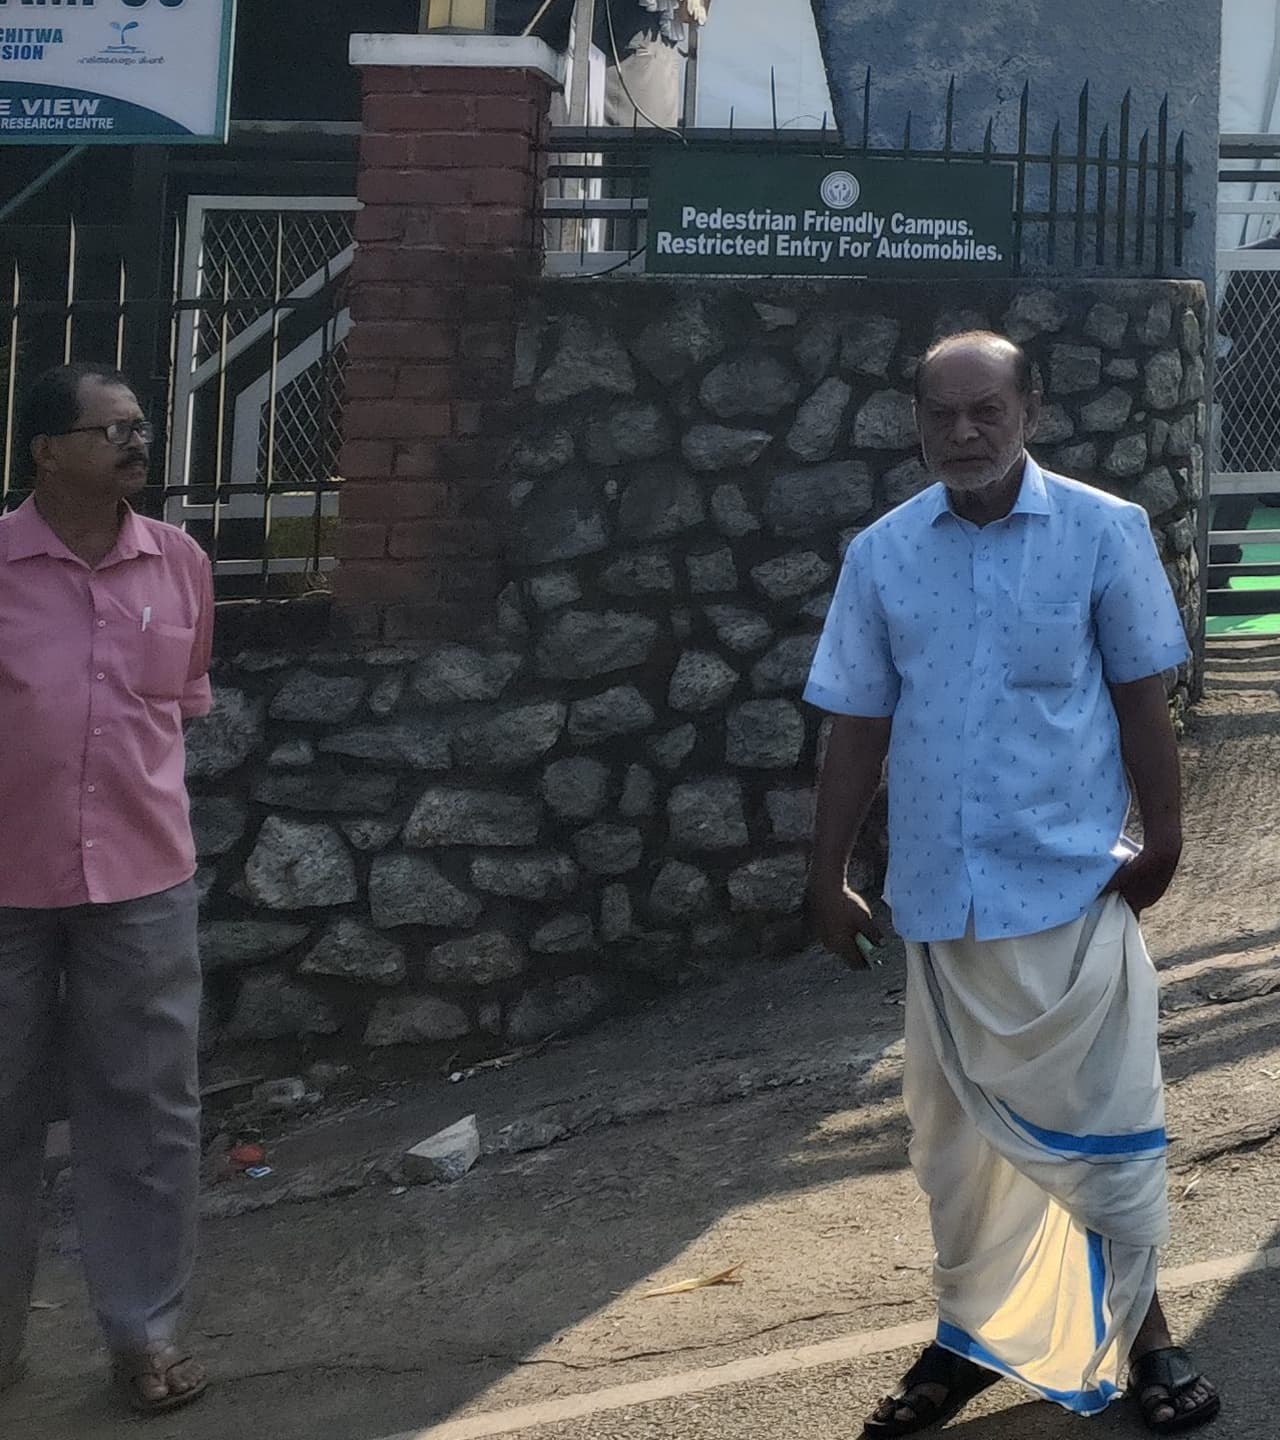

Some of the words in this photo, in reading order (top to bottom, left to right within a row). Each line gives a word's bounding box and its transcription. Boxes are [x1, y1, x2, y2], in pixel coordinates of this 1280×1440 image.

[20, 98, 101, 116] VIEW
[0, 116, 64, 129] RESEARCH
[66, 117, 115, 130] CENTRE
[681, 205, 797, 234] Pedestrian
[802, 208, 886, 241] Friendly
[890, 213, 974, 242] Campus.
[656, 231, 771, 258] Restricted
[775, 233, 834, 264] Entry
[838, 235, 873, 260] For
[876, 237, 1003, 262] Automobiles.
